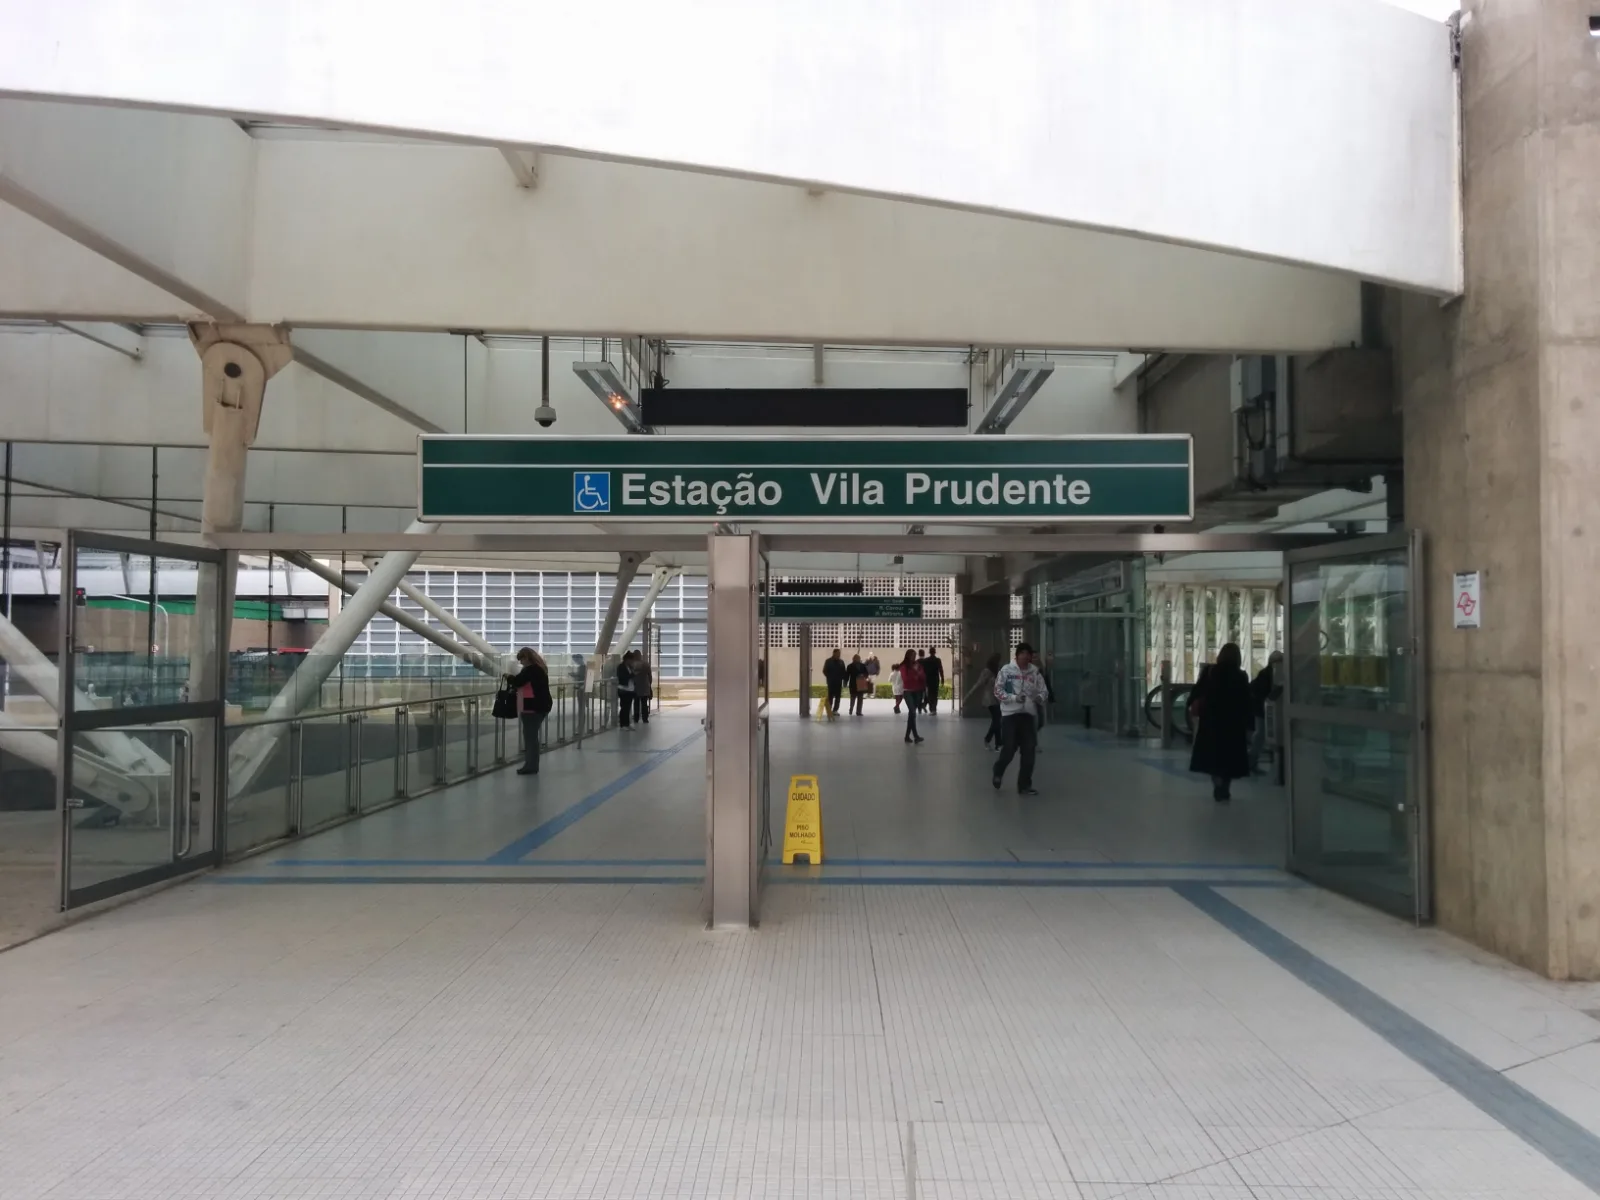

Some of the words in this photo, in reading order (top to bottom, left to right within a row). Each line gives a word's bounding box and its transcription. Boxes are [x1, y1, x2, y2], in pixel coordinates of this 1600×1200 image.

[622, 472, 782, 515] Estação
[810, 472, 885, 505] Vila
[906, 472, 1091, 505] Prudente
[792, 793, 816, 801] CUIDADO
